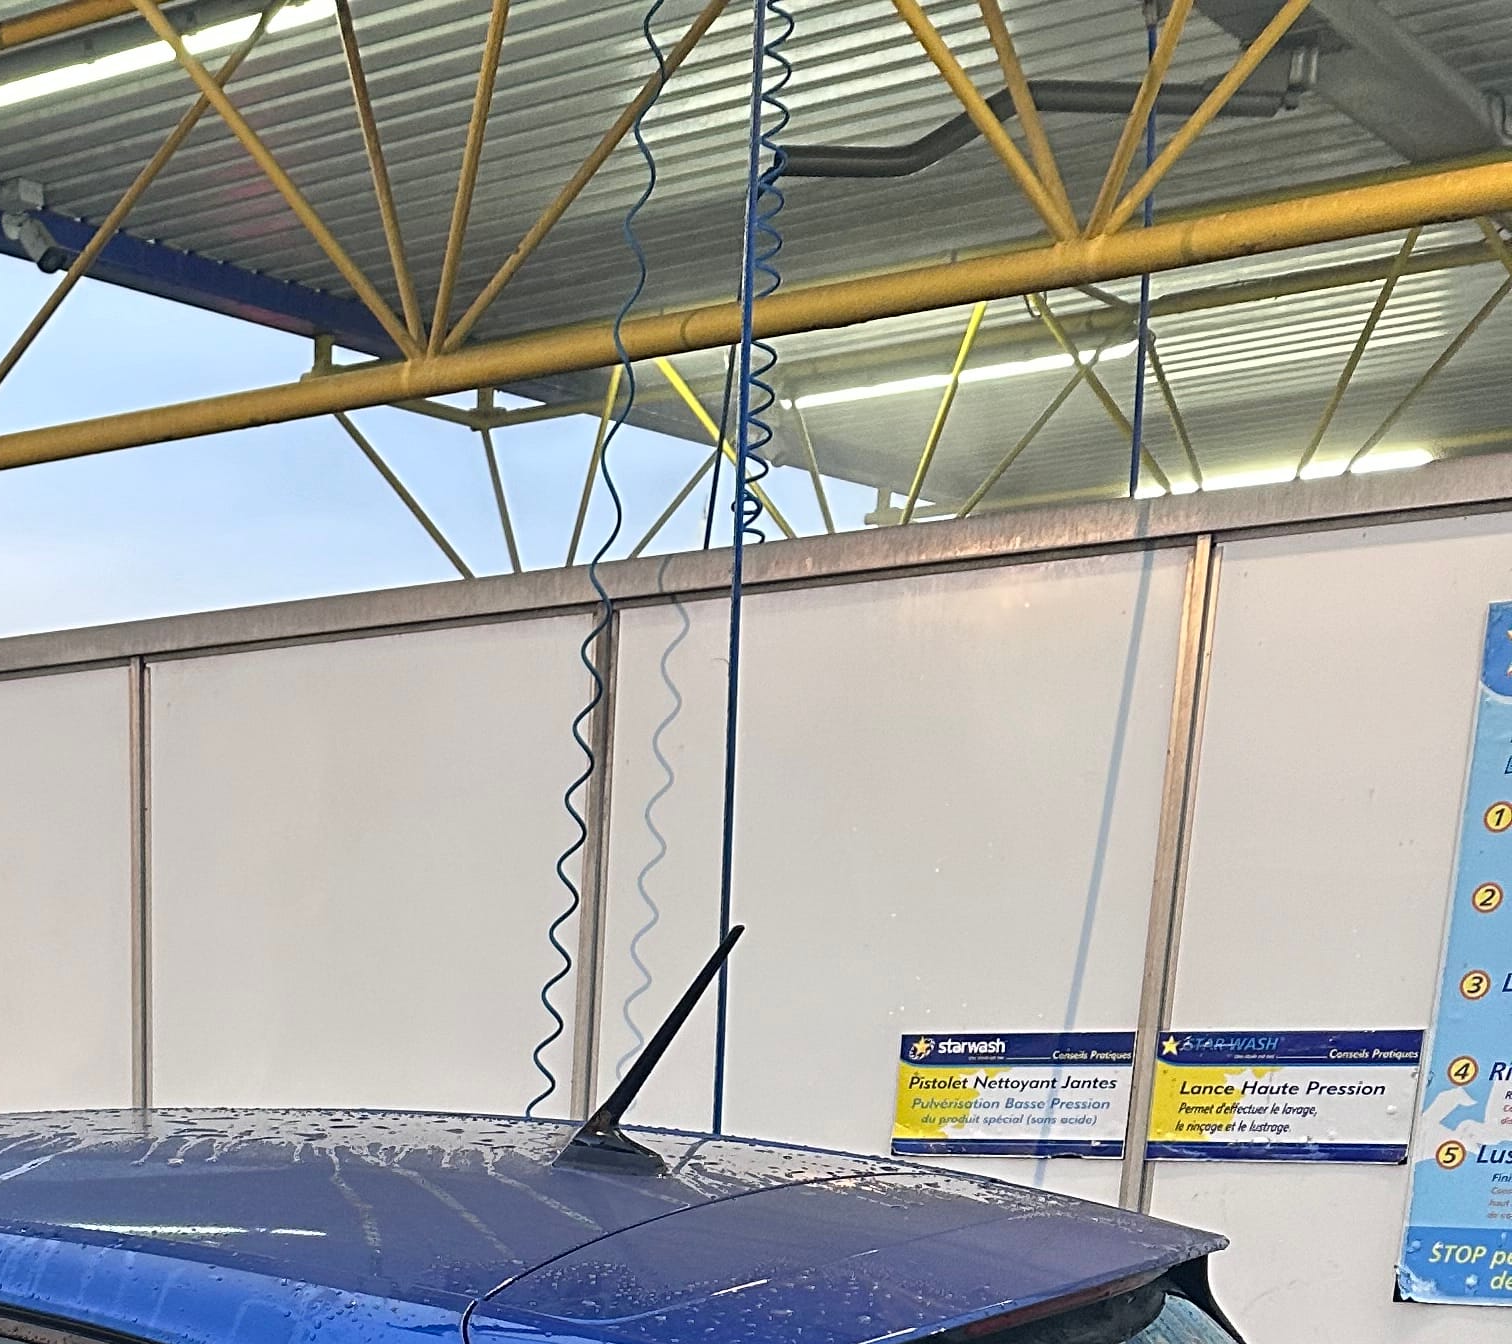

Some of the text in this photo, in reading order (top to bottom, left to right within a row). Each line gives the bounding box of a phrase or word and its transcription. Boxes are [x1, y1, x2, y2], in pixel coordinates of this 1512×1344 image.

[1495, 809, 1504, 827] 1
[1480, 889, 1495, 905] 2
[1467, 976, 1483, 993] 3
[938, 1038, 1006, 1054] starwash
[1230, 1037, 1280, 1051] WASH
[1052, 1050, 1132, 1061] Conseils Pratiques
[1329, 1049, 1419, 1061] Conseils Pratiques
[1454, 1062, 1470, 1080] 4
[909, 1076, 1118, 1092] Pistolet Nettoyant Jantes
[1180, 1080, 1386, 1095] Lance Haute Pression
[912, 1097, 1110, 1110] Pulvérisation Basse Pression
[1178, 1102, 1317, 1118] Permet d'effectuer le lavage,
[921, 1114, 1097, 1126] du produit spécial (sans acide)
[1175, 1121, 1184, 1132] le
[1186, 1122, 1223, 1135] rinçage
[1225, 1121, 1236, 1132] et
[1238, 1120, 1247, 1132] le
[1443, 1147, 1459, 1164] 5
[1428, 1241, 1487, 1264] STOP
